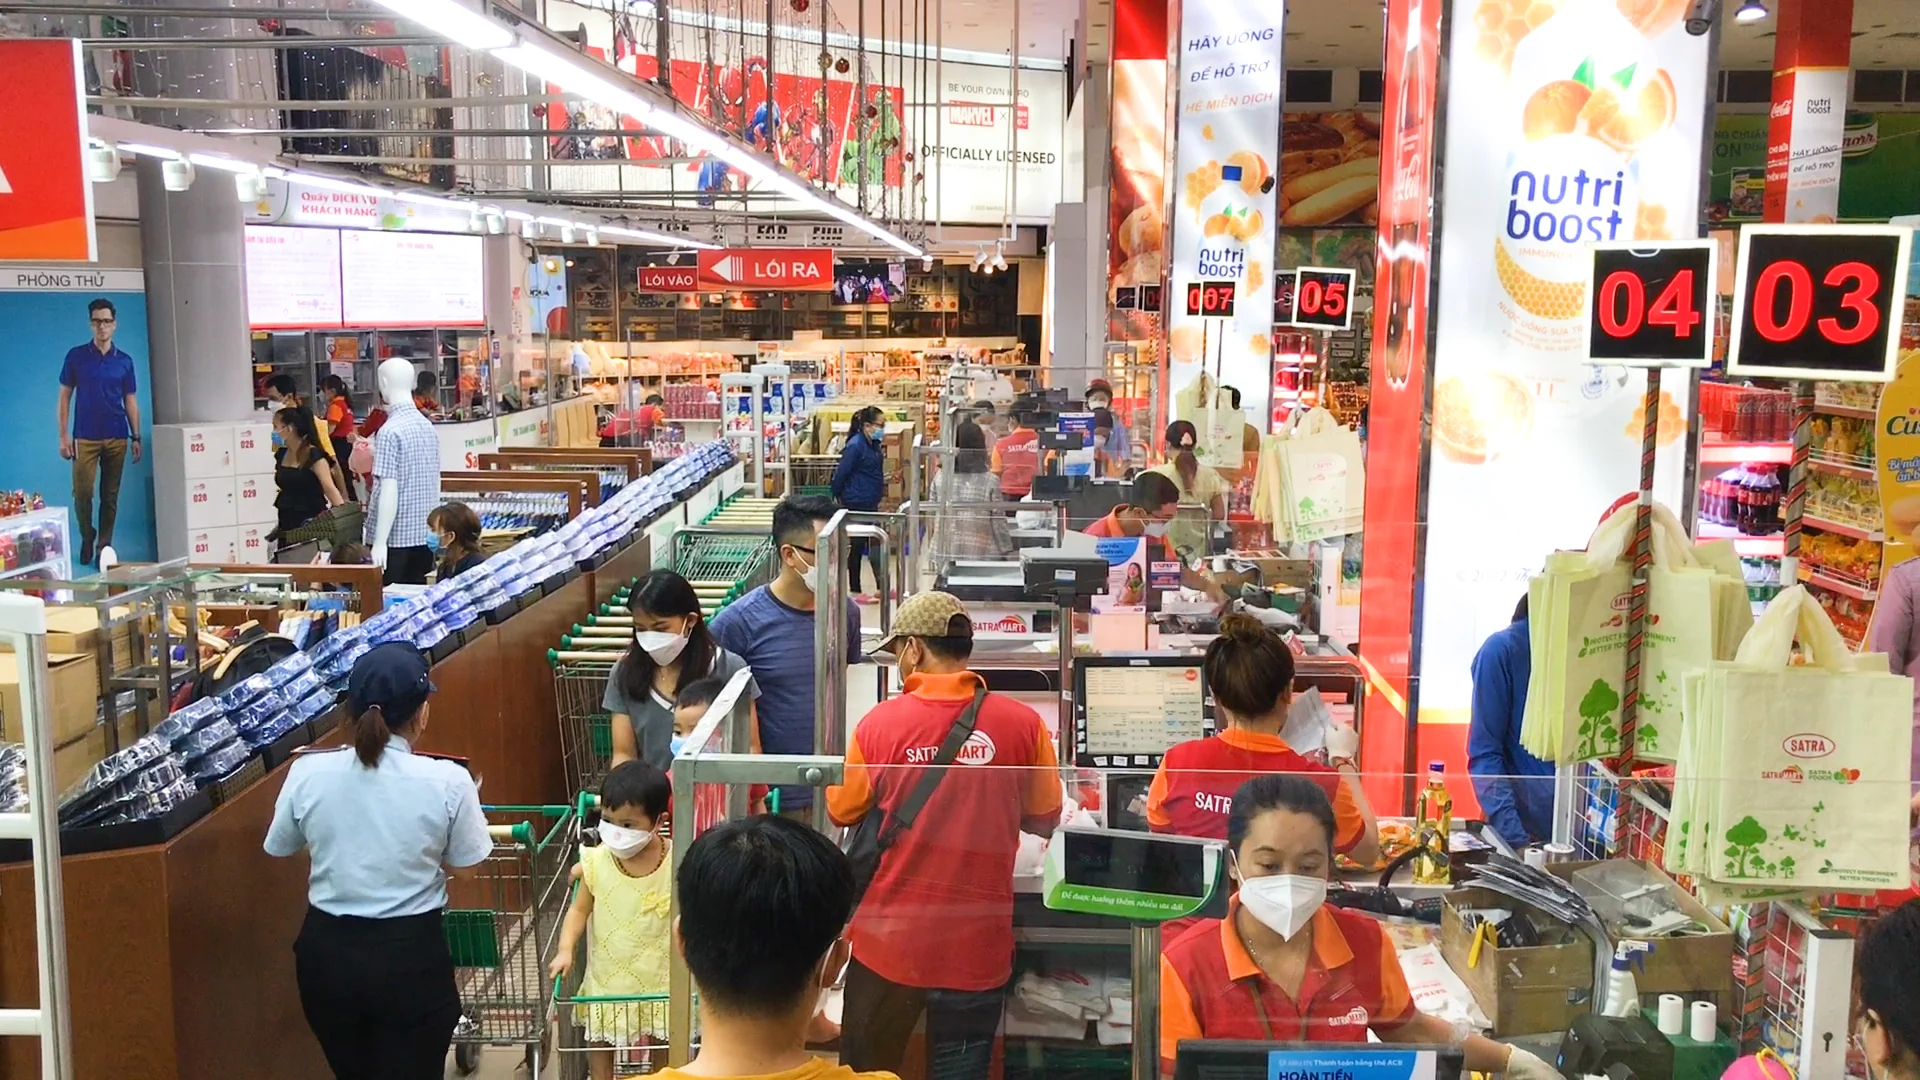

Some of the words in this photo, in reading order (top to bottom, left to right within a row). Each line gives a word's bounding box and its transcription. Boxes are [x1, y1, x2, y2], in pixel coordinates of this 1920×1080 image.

[1188, 34, 1222, 51] HÃY
[1214, 62, 1235, 79] HỖ
[949, 83, 959, 93] BE
[961, 84, 984, 95] YOUR
[986, 86, 1006, 97] OWN
[1007, 88, 1029, 99] HRO
[950, 105, 994, 126] MARVEL
[1843, 131, 1876, 149] norr
[921, 145, 993, 162] OFFICIALLY
[996, 150, 1056, 165] LICENSED
[1511, 169, 1624, 207] nutri
[1505, 202, 1623, 244] boost
[1200, 248, 1244, 262] nutri
[791, 261, 820, 278] RA
[1198, 260, 1244, 278] boost
[17, 271, 71, 287] PHÒNG
[75, 271, 105, 287] THỬ
[667, 273, 694, 286] VÀO
[1300, 280, 1345, 317] 05
[1599, 269, 1700, 339] 04
[1752, 260, 1881, 345] 03
[1886, 415, 1920, 435] Cu
[190, 443, 205, 452] 025
[240, 440, 255, 449] 026
[465, 451, 478, 469] Sa
[243, 489, 257, 498] 029
[195, 544, 209, 553] 031
[246, 539, 260, 548] 032
[972, 621, 1026, 632] SATRAMART
[1791, 739, 1826, 752] SATRA
[1195, 791, 1232, 815] SATR
[1061, 890, 1072, 900] Để
[1116, 896, 1136, 907] thêm
[1278, 1069, 1320, 1080] HOÀN
[1322, 1068, 1353, 1080] TIỀN
